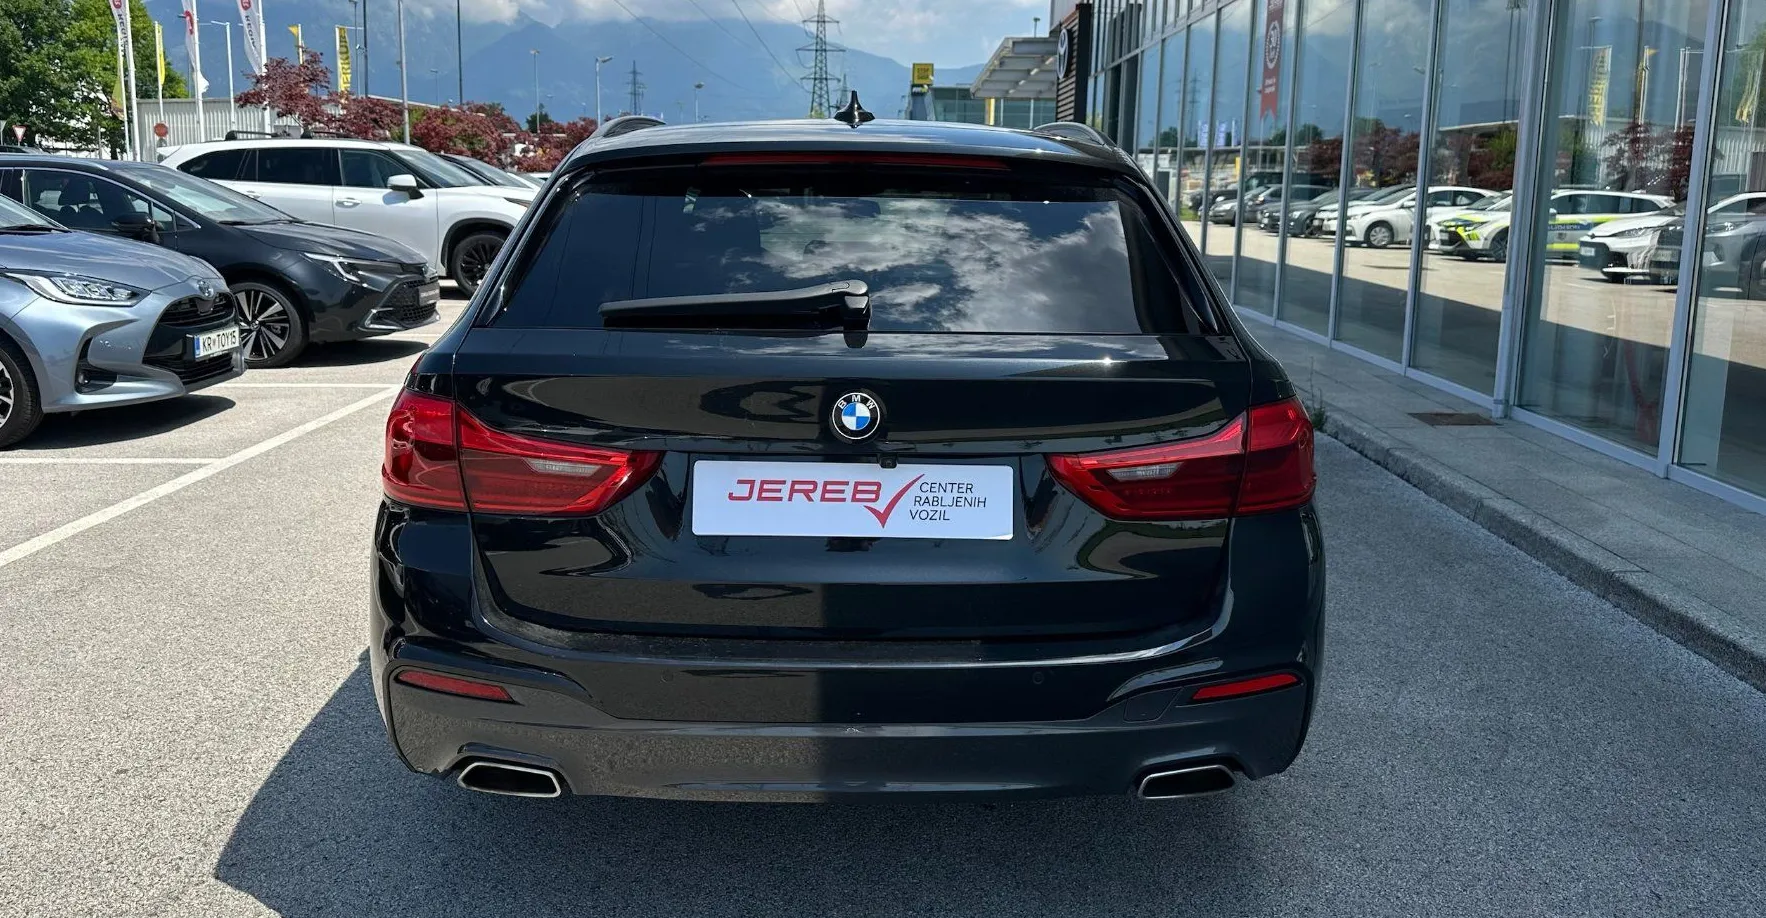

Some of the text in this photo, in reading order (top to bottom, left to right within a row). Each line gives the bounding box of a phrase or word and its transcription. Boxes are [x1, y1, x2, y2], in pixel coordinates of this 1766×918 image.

[338, 36, 351, 90] ERKUR
[203, 331, 236, 352] KR TOY15
[837, 394, 876, 410] BMW
[728, 479, 882, 503] JEREB
[919, 481, 974, 494] CENTER
[913, 495, 987, 508] RABLJENIH
[909, 509, 951, 521] VOZIL
